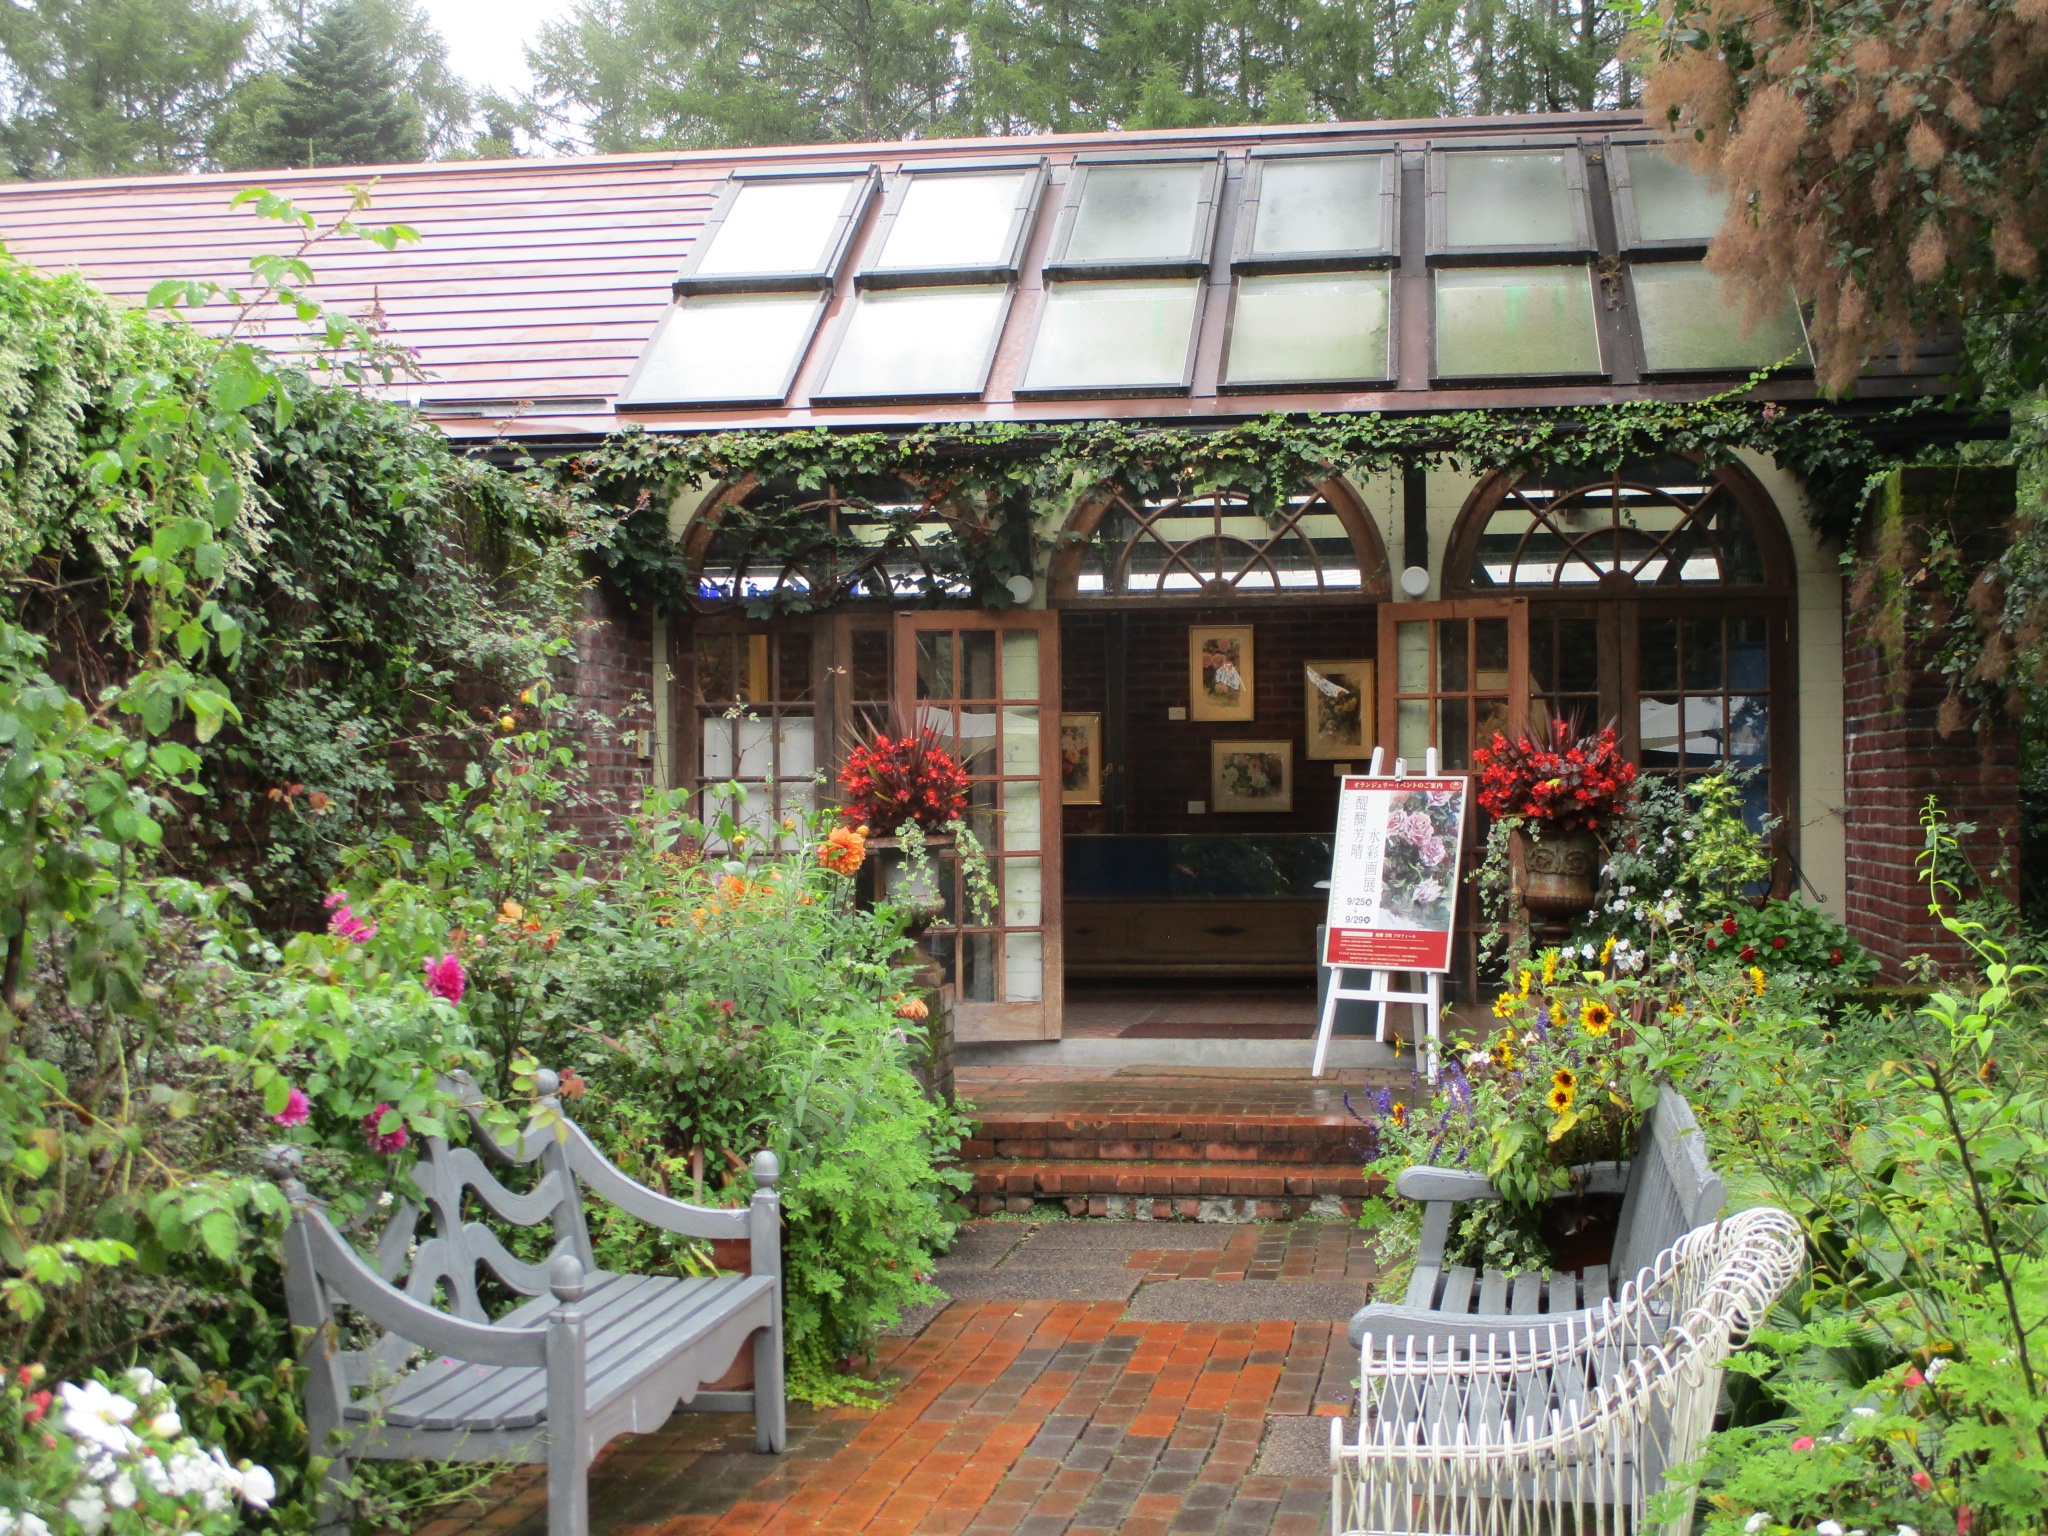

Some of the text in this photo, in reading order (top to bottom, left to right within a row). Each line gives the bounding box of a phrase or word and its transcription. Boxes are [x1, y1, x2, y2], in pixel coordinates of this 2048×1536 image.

[1353, 781, 1443, 789] オランジェリーイベントのご案内
[1350, 795, 1369, 860] 醍醐芳晴
[1364, 828, 1381, 893] 水彩画展
